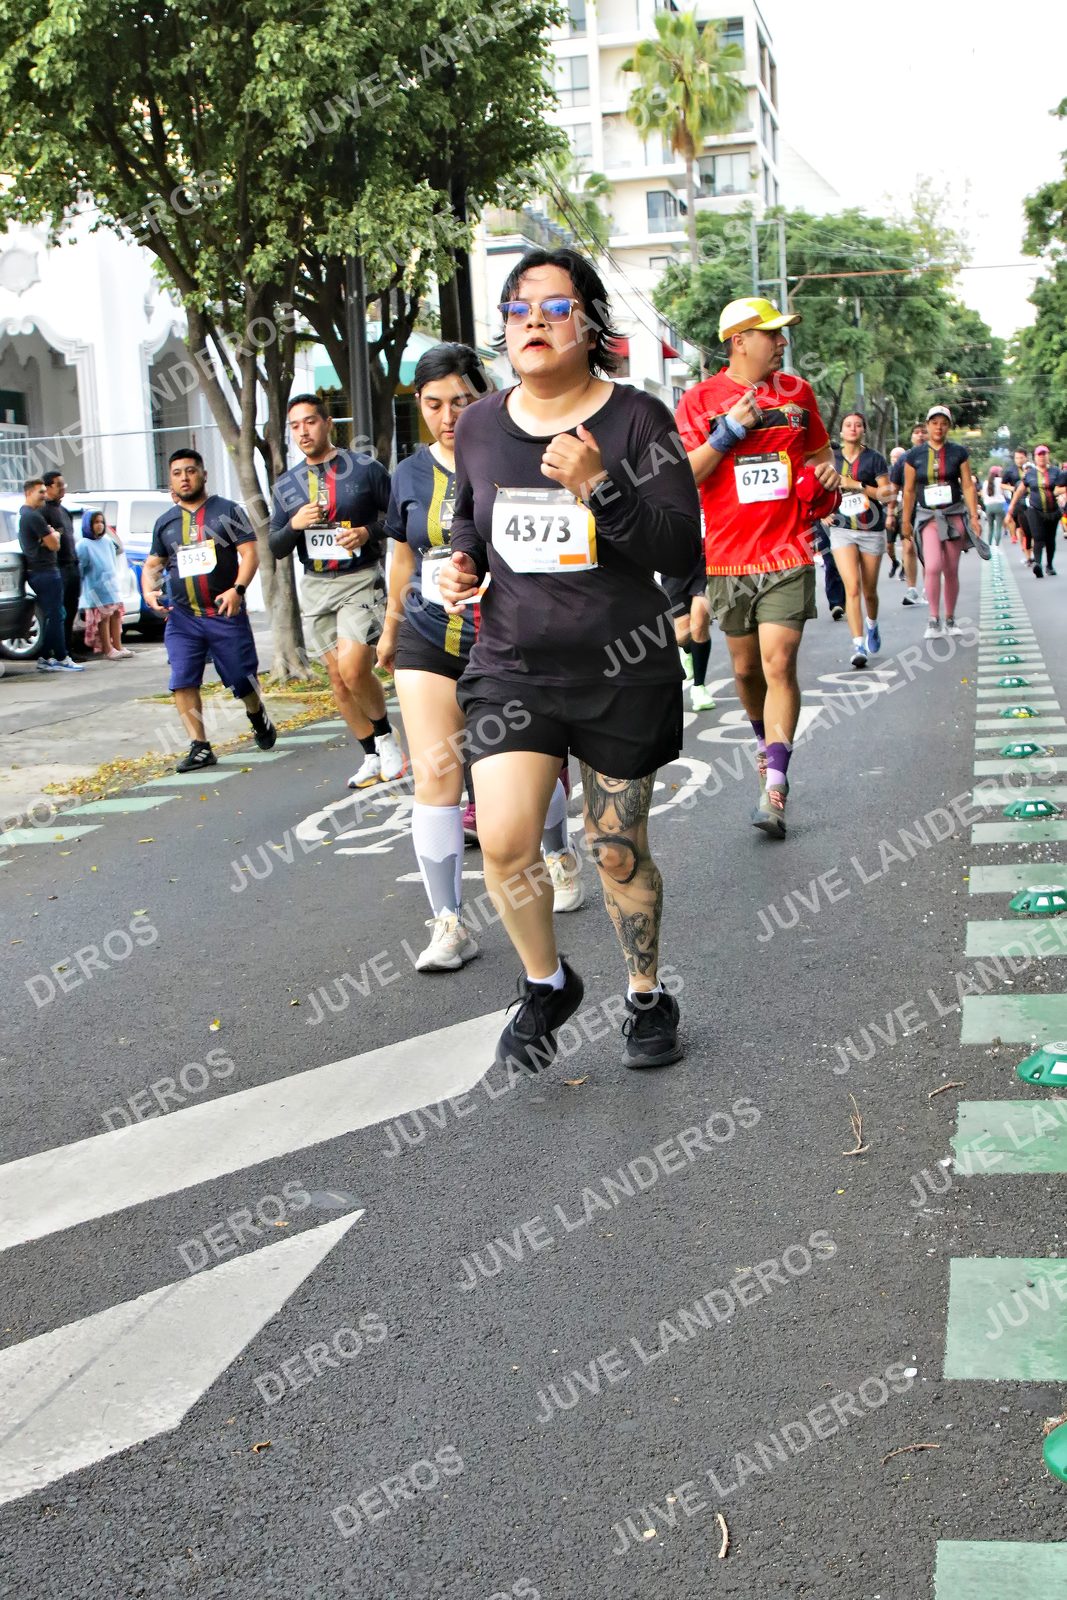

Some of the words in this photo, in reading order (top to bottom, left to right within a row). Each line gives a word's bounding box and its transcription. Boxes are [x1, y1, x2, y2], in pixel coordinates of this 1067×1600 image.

[742, 468, 779, 486] 6723
[505, 514, 571, 543] 4373
[311, 534, 339, 547] 670
